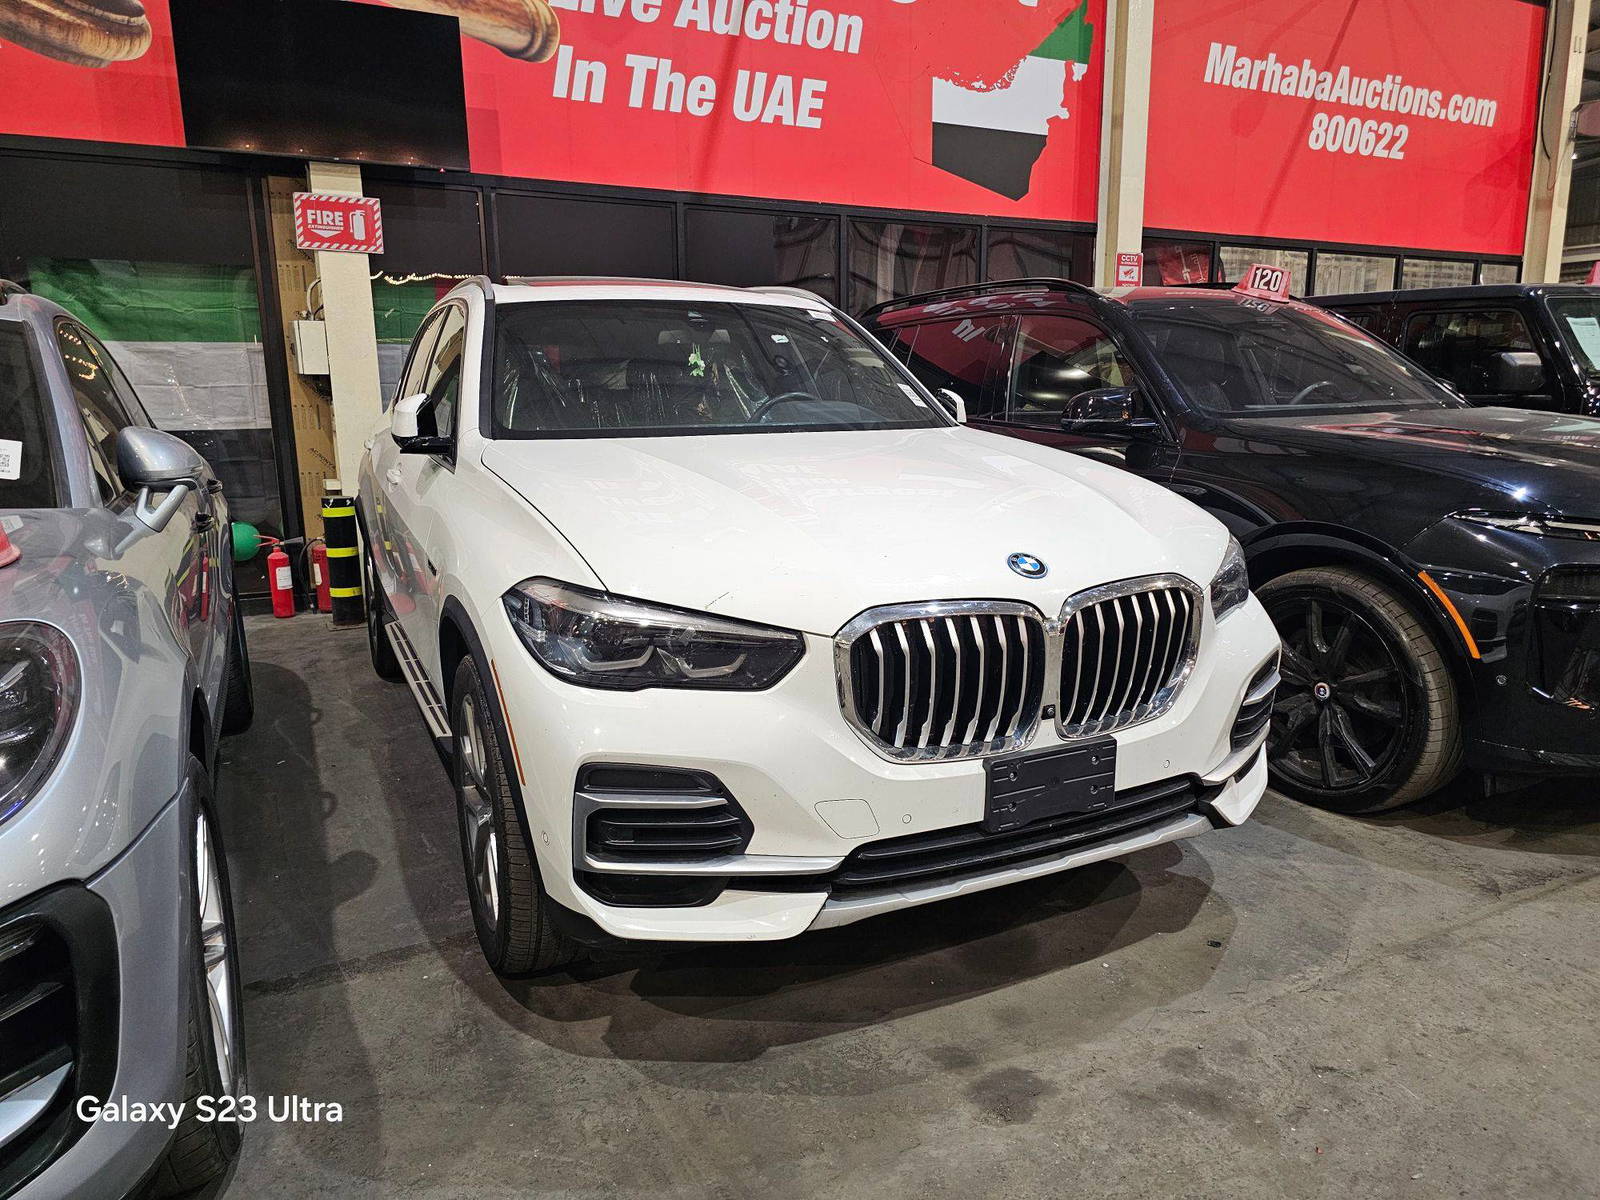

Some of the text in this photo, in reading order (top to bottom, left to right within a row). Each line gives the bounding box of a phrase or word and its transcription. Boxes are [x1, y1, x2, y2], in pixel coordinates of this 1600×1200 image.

[673, 0, 864, 54] Auction
[552, 45, 828, 129] In The UAE
[1203, 43, 1497, 127] MarhabaAuctions.com
[1308, 113, 1409, 160] 800622
[306, 209, 344, 226] FIRE
[1253, 268, 1283, 292] 120
